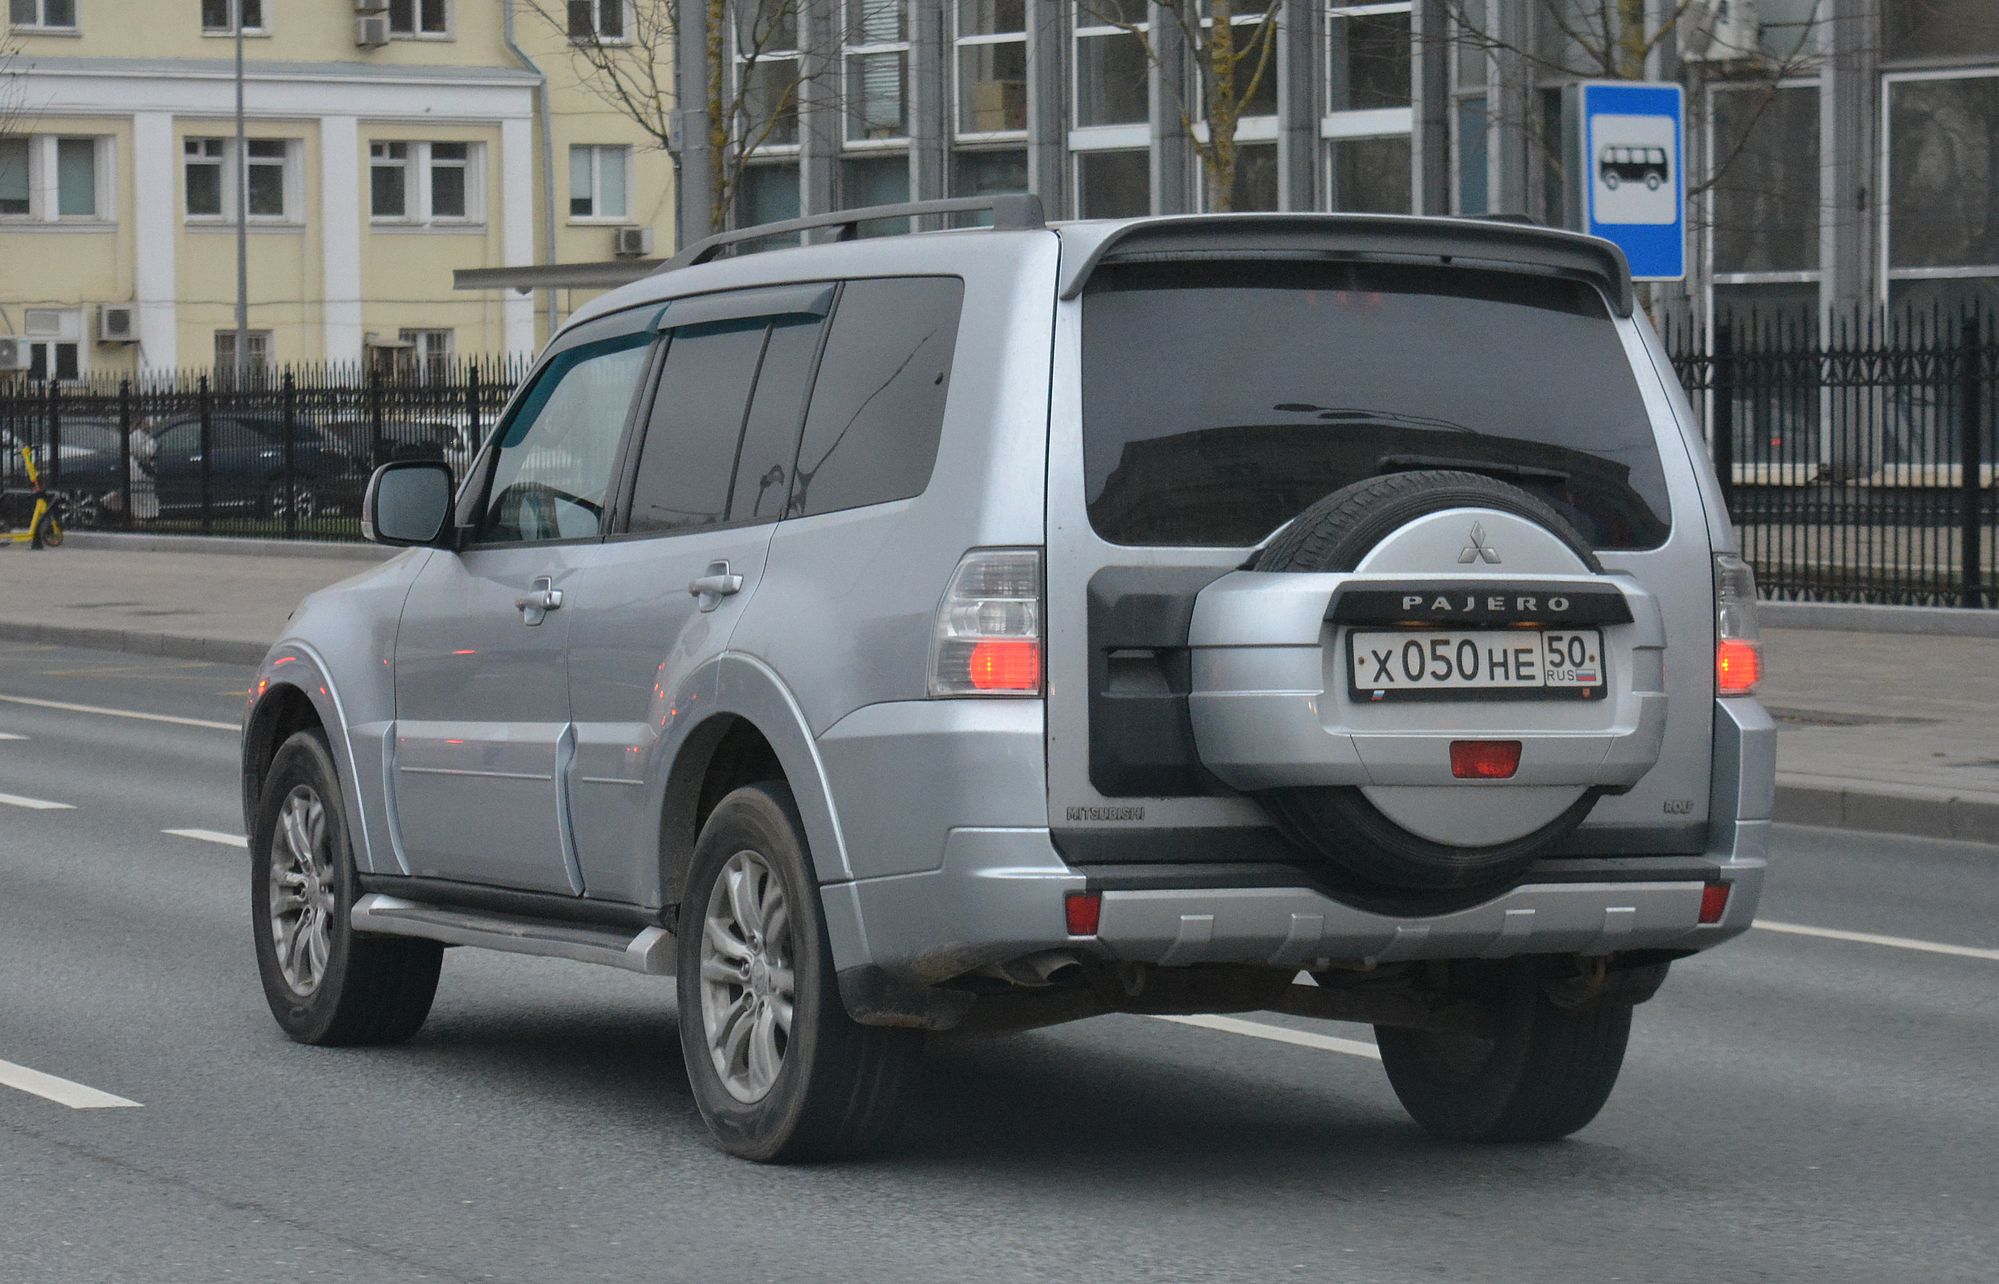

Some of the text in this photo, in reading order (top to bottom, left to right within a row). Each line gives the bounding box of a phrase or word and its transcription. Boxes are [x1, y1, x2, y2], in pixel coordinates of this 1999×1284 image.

[1402, 595, 1570, 612] PAJERO
[1547, 635, 1586, 668] 50
[1546, 669, 1575, 682] RUS
[1066, 806, 1145, 821] MITSUBISHI
